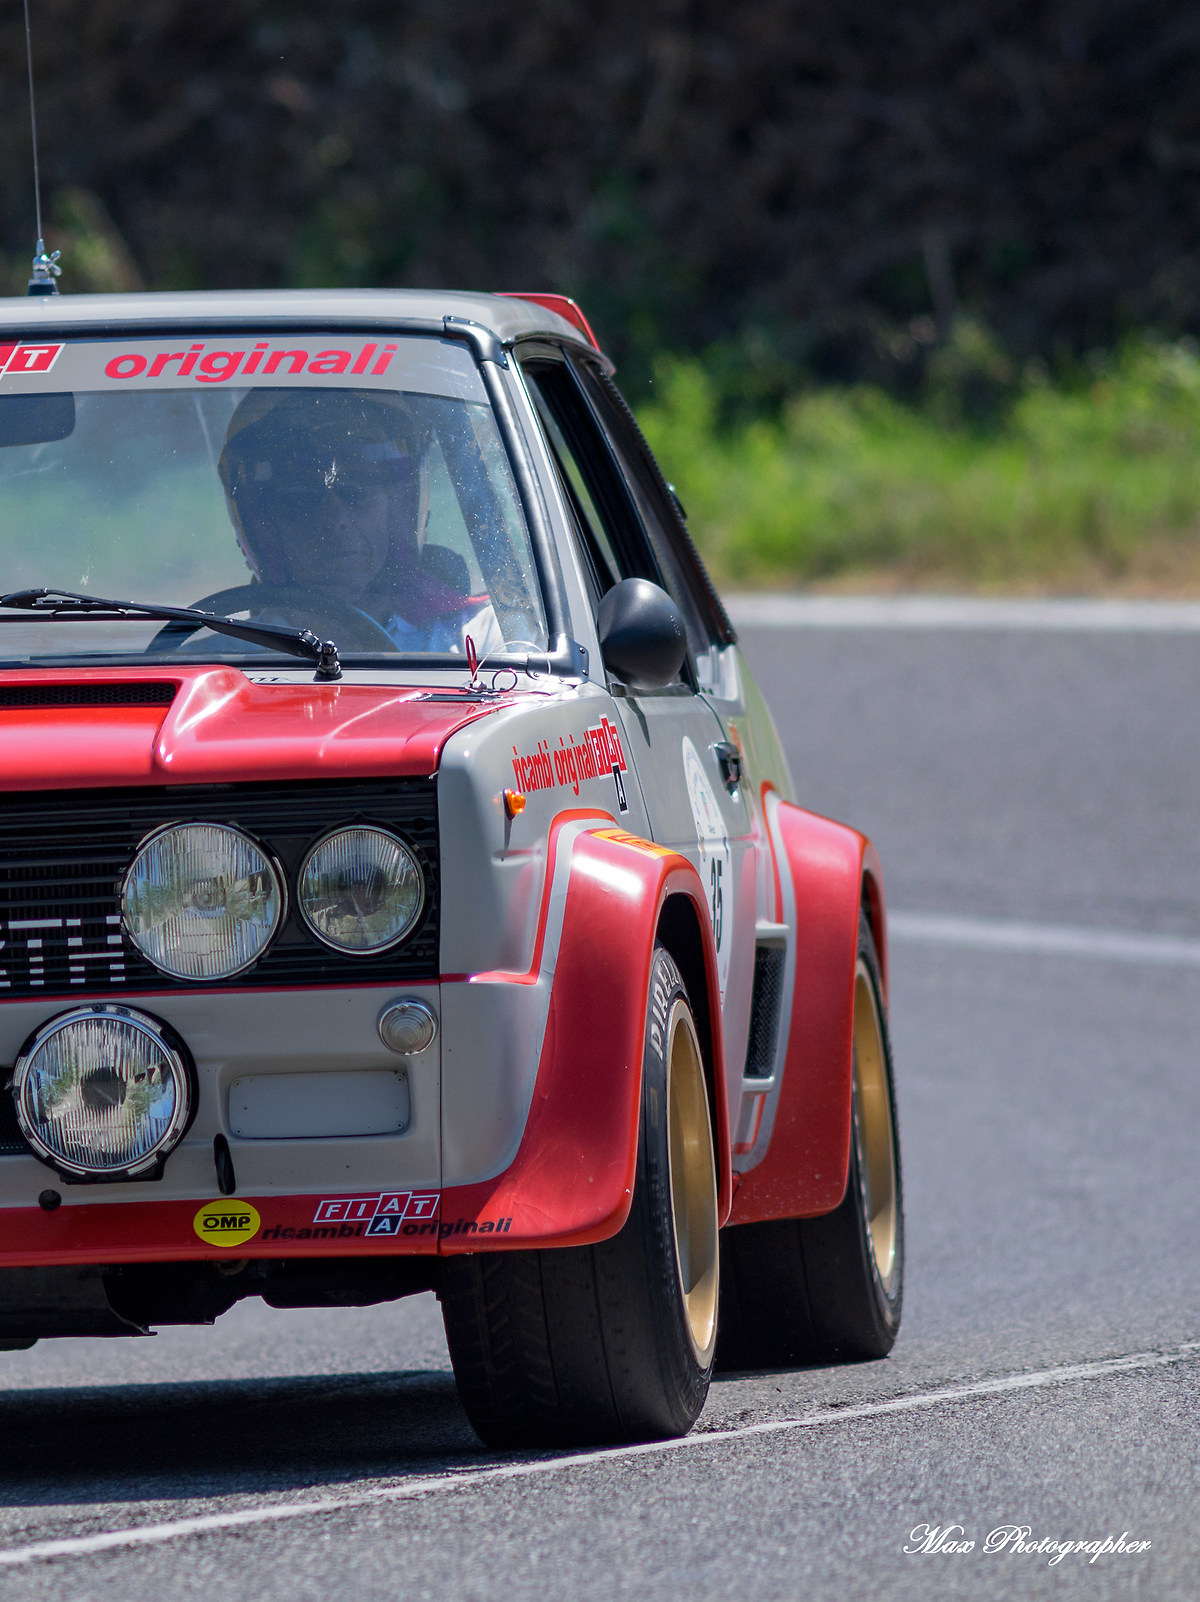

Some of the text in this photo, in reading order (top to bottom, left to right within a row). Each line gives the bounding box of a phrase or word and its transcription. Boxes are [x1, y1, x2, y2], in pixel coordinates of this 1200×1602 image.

[103, 342, 399, 383] originali
[511, 740, 555, 794] ricambi
[553, 730, 599, 796] originali
[323, 1197, 430, 1218] FIAT
[202, 1215, 251, 1230] OMP
[261, 1223, 365, 1241] ricambi
[402, 1217, 513, 1240] originali
